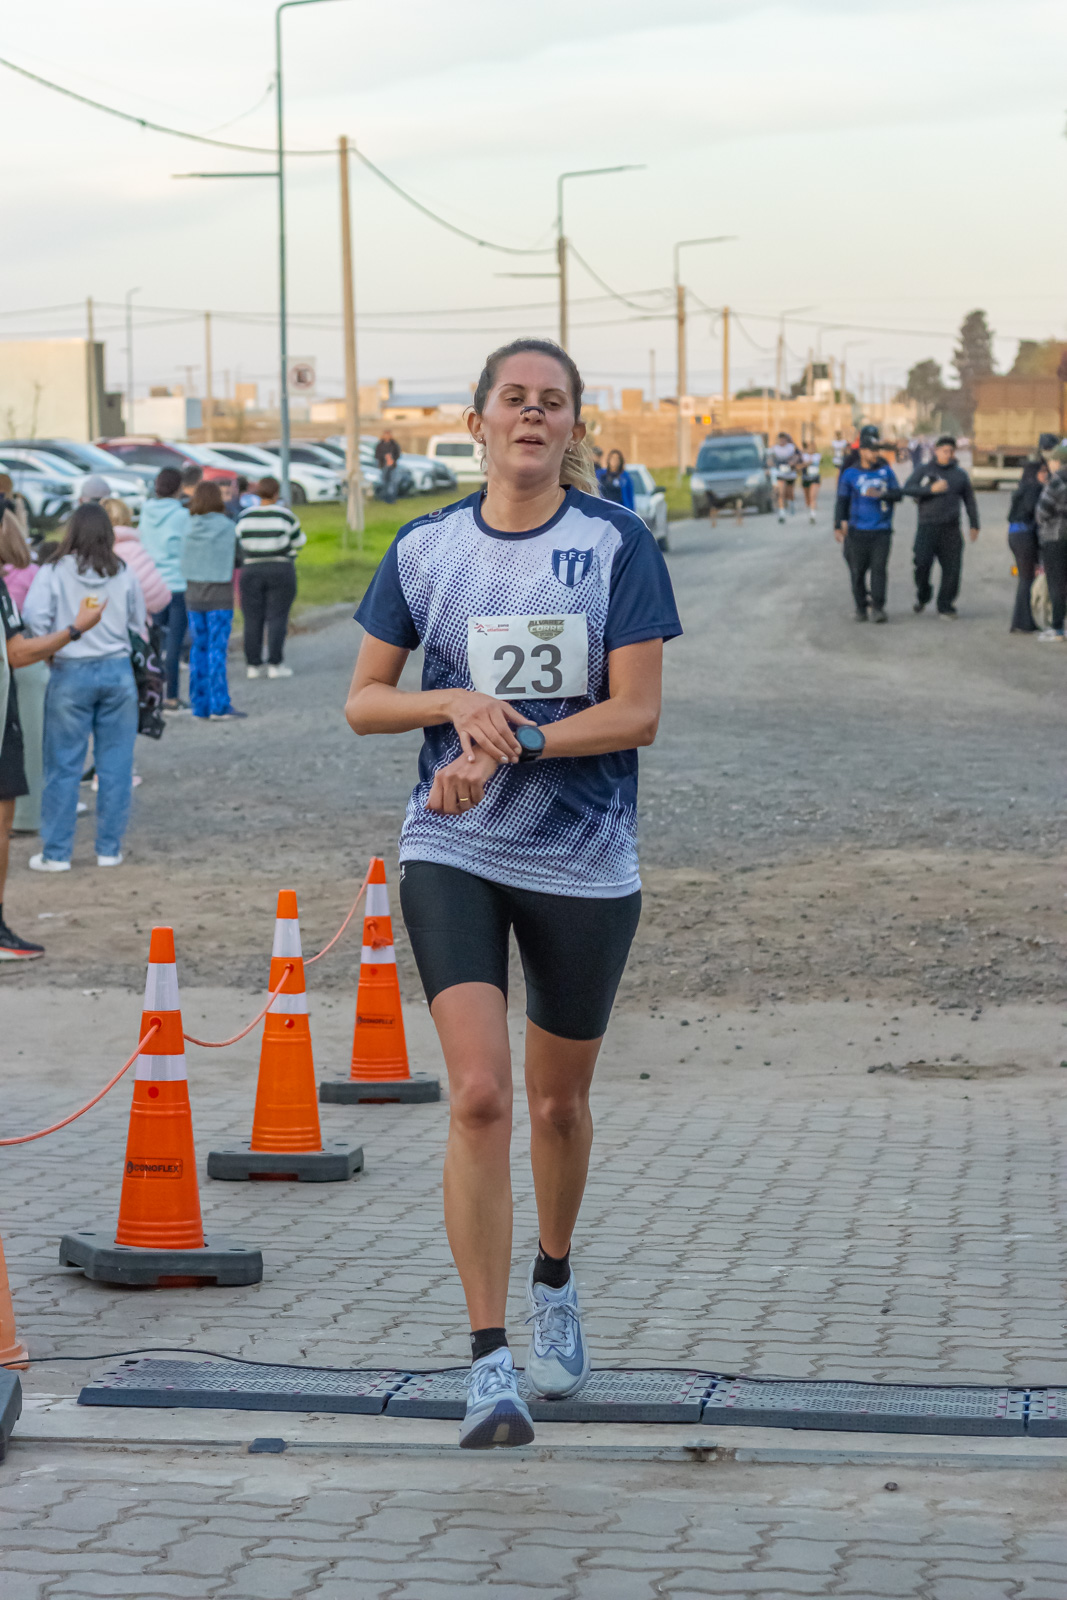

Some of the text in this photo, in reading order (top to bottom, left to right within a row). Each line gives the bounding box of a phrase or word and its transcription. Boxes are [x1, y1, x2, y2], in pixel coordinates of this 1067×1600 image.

[559, 551, 587, 561] SFC
[494, 644, 562, 694] 23
[134, 1164, 179, 1172] CONOFLEX
